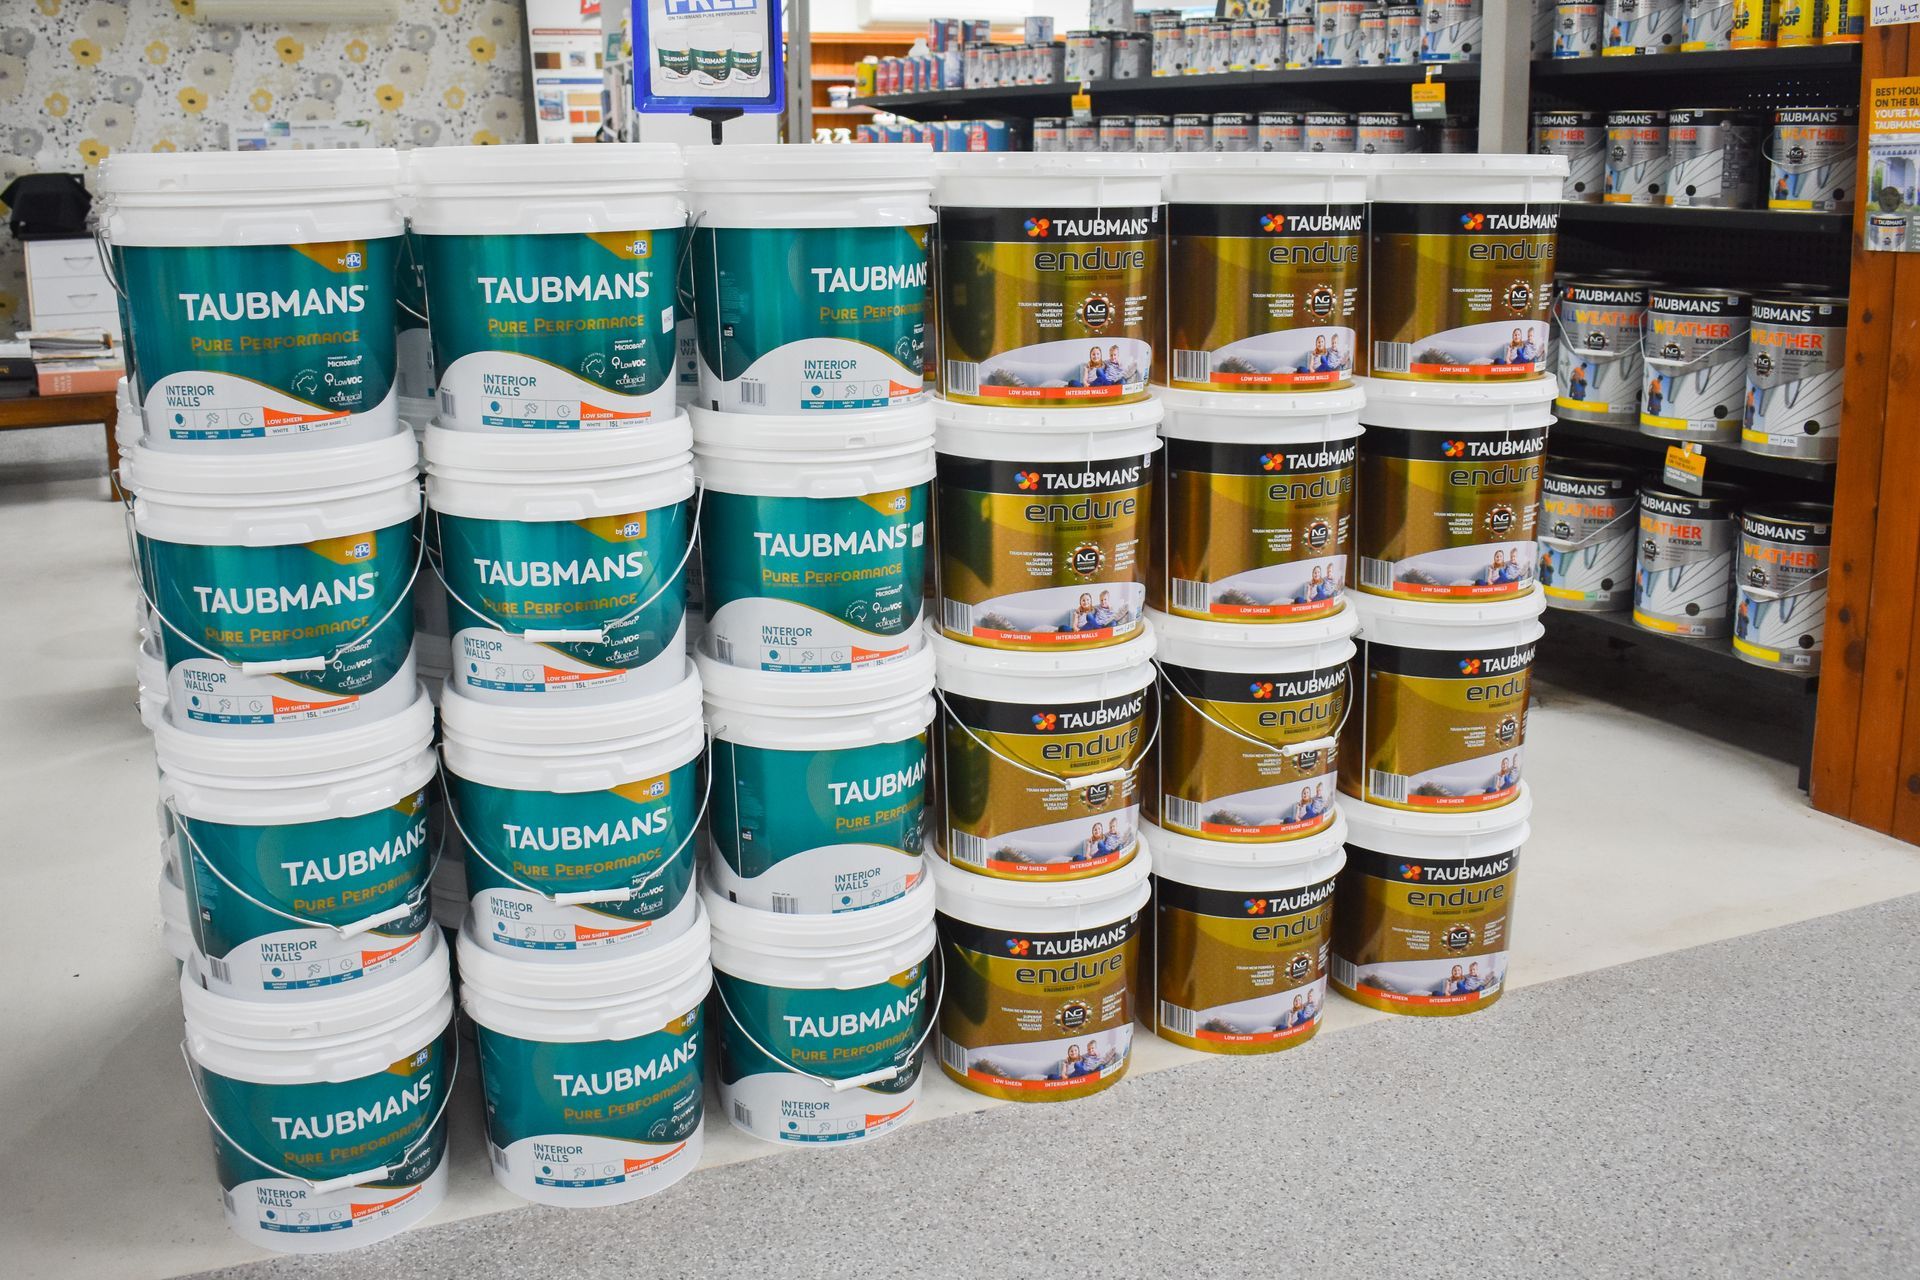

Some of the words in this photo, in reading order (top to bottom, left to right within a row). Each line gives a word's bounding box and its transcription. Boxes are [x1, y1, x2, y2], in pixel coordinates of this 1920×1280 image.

[1876, 88, 1896, 96] BEST
[1875, 99, 1888, 107] ON
[1891, 98, 1907, 106] THE
[1780, 112, 1838, 122] TAUBMANS
[1052, 219, 1148, 236] TAUBMANS
[1287, 215, 1361, 231] TAUBMANS
[1487, 214, 1557, 229] TAUBMANS
[1034, 246, 1144, 271] endure
[1269, 241, 1358, 264] endure
[1469, 239, 1554, 260] endure
[478, 272, 650, 304] TAUBMANS
[1574, 288, 1642, 303] TAUBMANS
[179, 285, 366, 321] TAUBMANS
[1654, 297, 1720, 312] TAUBMANS
[820, 306, 858, 320] PURE
[488, 318, 528, 333] PURE
[534, 314, 645, 332] PERFORMANCE
[192, 336, 233, 352] PURE
[240, 330, 360, 350] PERFORMANCE
[804, 360, 856, 370] INTERIOR
[483, 374, 537, 387] INTERIOR
[804, 370, 842, 380] WALLS
[165, 385, 214, 397] INTERIOR
[484, 385, 520, 397] WALLS
[167, 396, 200, 408] WALLS
[1468, 437, 1544, 456] TAUBMANS
[1286, 446, 1355, 470] TAUBMANS
[1043, 466, 1139, 489] TAUBMANS
[1450, 464, 1539, 486] endure
[1269, 475, 1351, 501] endure
[1025, 497, 1136, 523] endure
[754, 523, 907, 557] TAUBMANS
[474, 551, 643, 587] TAUBMANS
[762, 569, 799, 583] PURE
[805, 563, 902, 583] PERFORMANCE
[193, 572, 375, 614] TAUBMANS
[525, 592, 638, 615] PERFORMANCE
[250, 615, 370, 641] PERFORMANCE
[762, 625, 813, 637] INTERIOR
[464, 637, 502, 652] INTERIOR
[762, 635, 797, 646] WALLS
[465, 648, 491, 660] WALLS
[1483, 646, 1536, 672] TAUBMAN
[183, 669, 227, 684] INTERIOR
[184, 680, 214, 692] WALLS
[1276, 669, 1345, 697] TAUBMANS
[1467, 678, 1525, 700] endu
[1059, 698, 1141, 728] TAUBMANS
[1258, 696, 1342, 727] endure
[1042, 726, 1139, 760] endure
[828, 754, 926, 806] TAUBMAN
[503, 808, 667, 851] TAUBMANS
[836, 816, 871, 829] PURE
[281, 818, 426, 887] TAUBMANS
[555, 848, 662, 875] PERFORMANCE
[834, 867, 881, 884] INTERIOR
[1424, 858, 1508, 881] TAUBMANS
[834, 879, 869, 892] WALLS
[294, 897, 335, 912] PURE
[490, 896, 533, 912] INTERIOR
[1269, 879, 1335, 912] TAUBMANS
[1407, 884, 1504, 907] endure
[491, 907, 520, 920] WALLS
[261, 940, 317, 953] INTERIOR
[1033, 925, 1126, 955] TAUBMANS
[261, 952, 302, 962] WALLS
[1016, 953, 1123, 984] endure
[783, 989, 919, 1038] TAUBMANS
[554, 1033, 697, 1097] TAUBMANS
[272, 1073, 431, 1140] TAUBMANS
[781, 1100, 830, 1110] INTERIOR
[781, 1108, 816, 1118] WALLS
[533, 1143, 583, 1155] INTERIOR
[534, 1151, 569, 1163] WALLS
[257, 1187, 306, 1199] INTERIOR
[257, 1196, 293, 1208] WALLS
